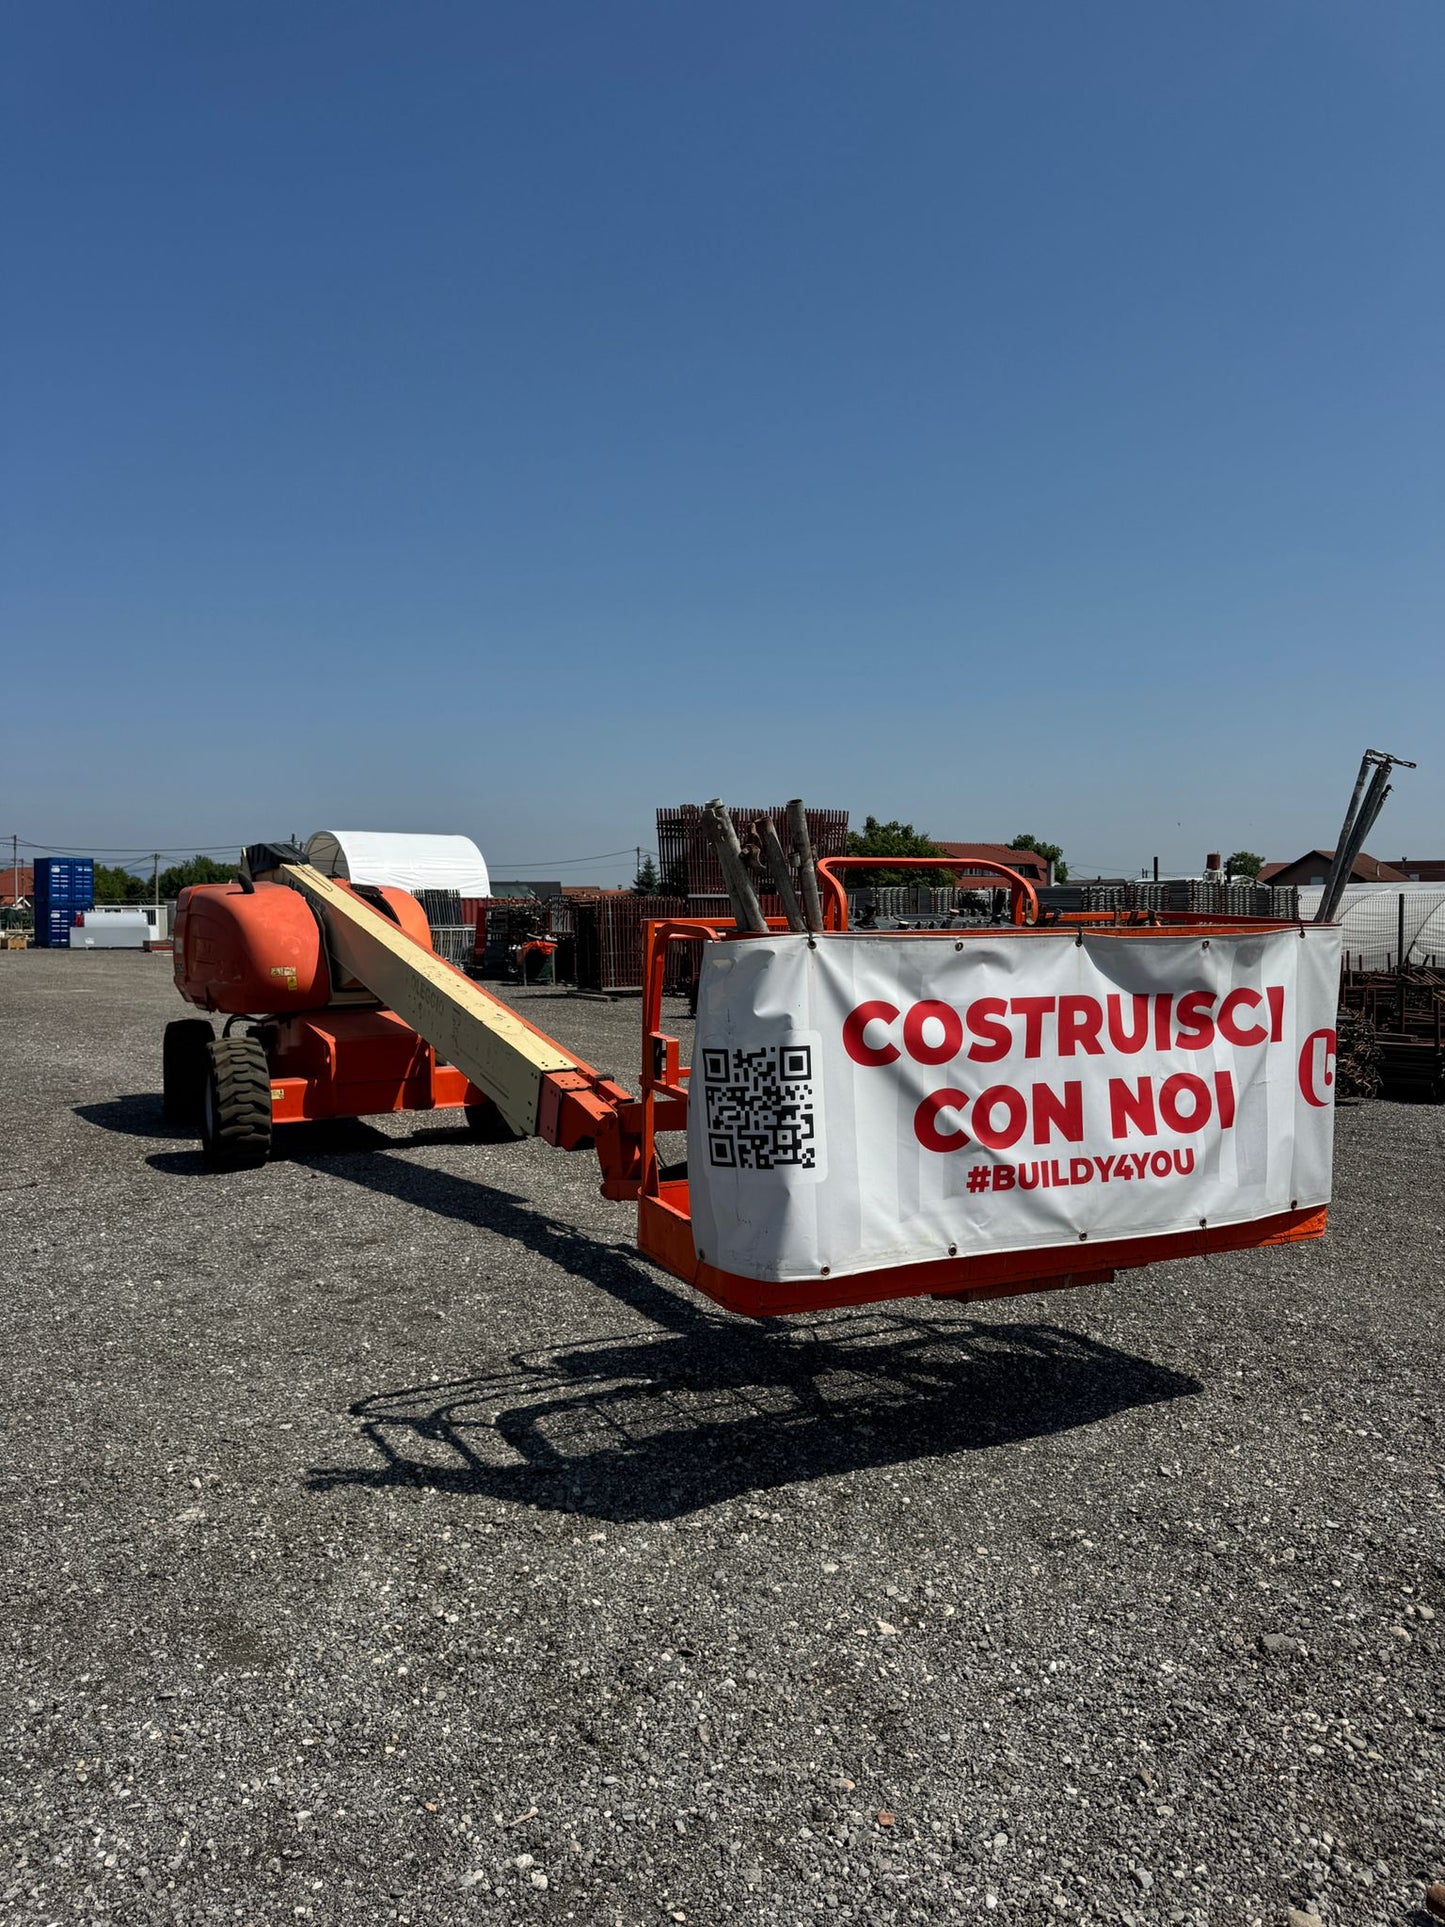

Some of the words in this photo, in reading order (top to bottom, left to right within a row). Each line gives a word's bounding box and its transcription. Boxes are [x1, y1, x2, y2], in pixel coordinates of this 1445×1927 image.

[842, 986, 1285, 1067] COSTRUISCI
[913, 1080, 1084, 1153] CON
[1108, 1070, 1236, 1140] NOI
[966, 1147, 1195, 1194] #BUILDY4YOU
